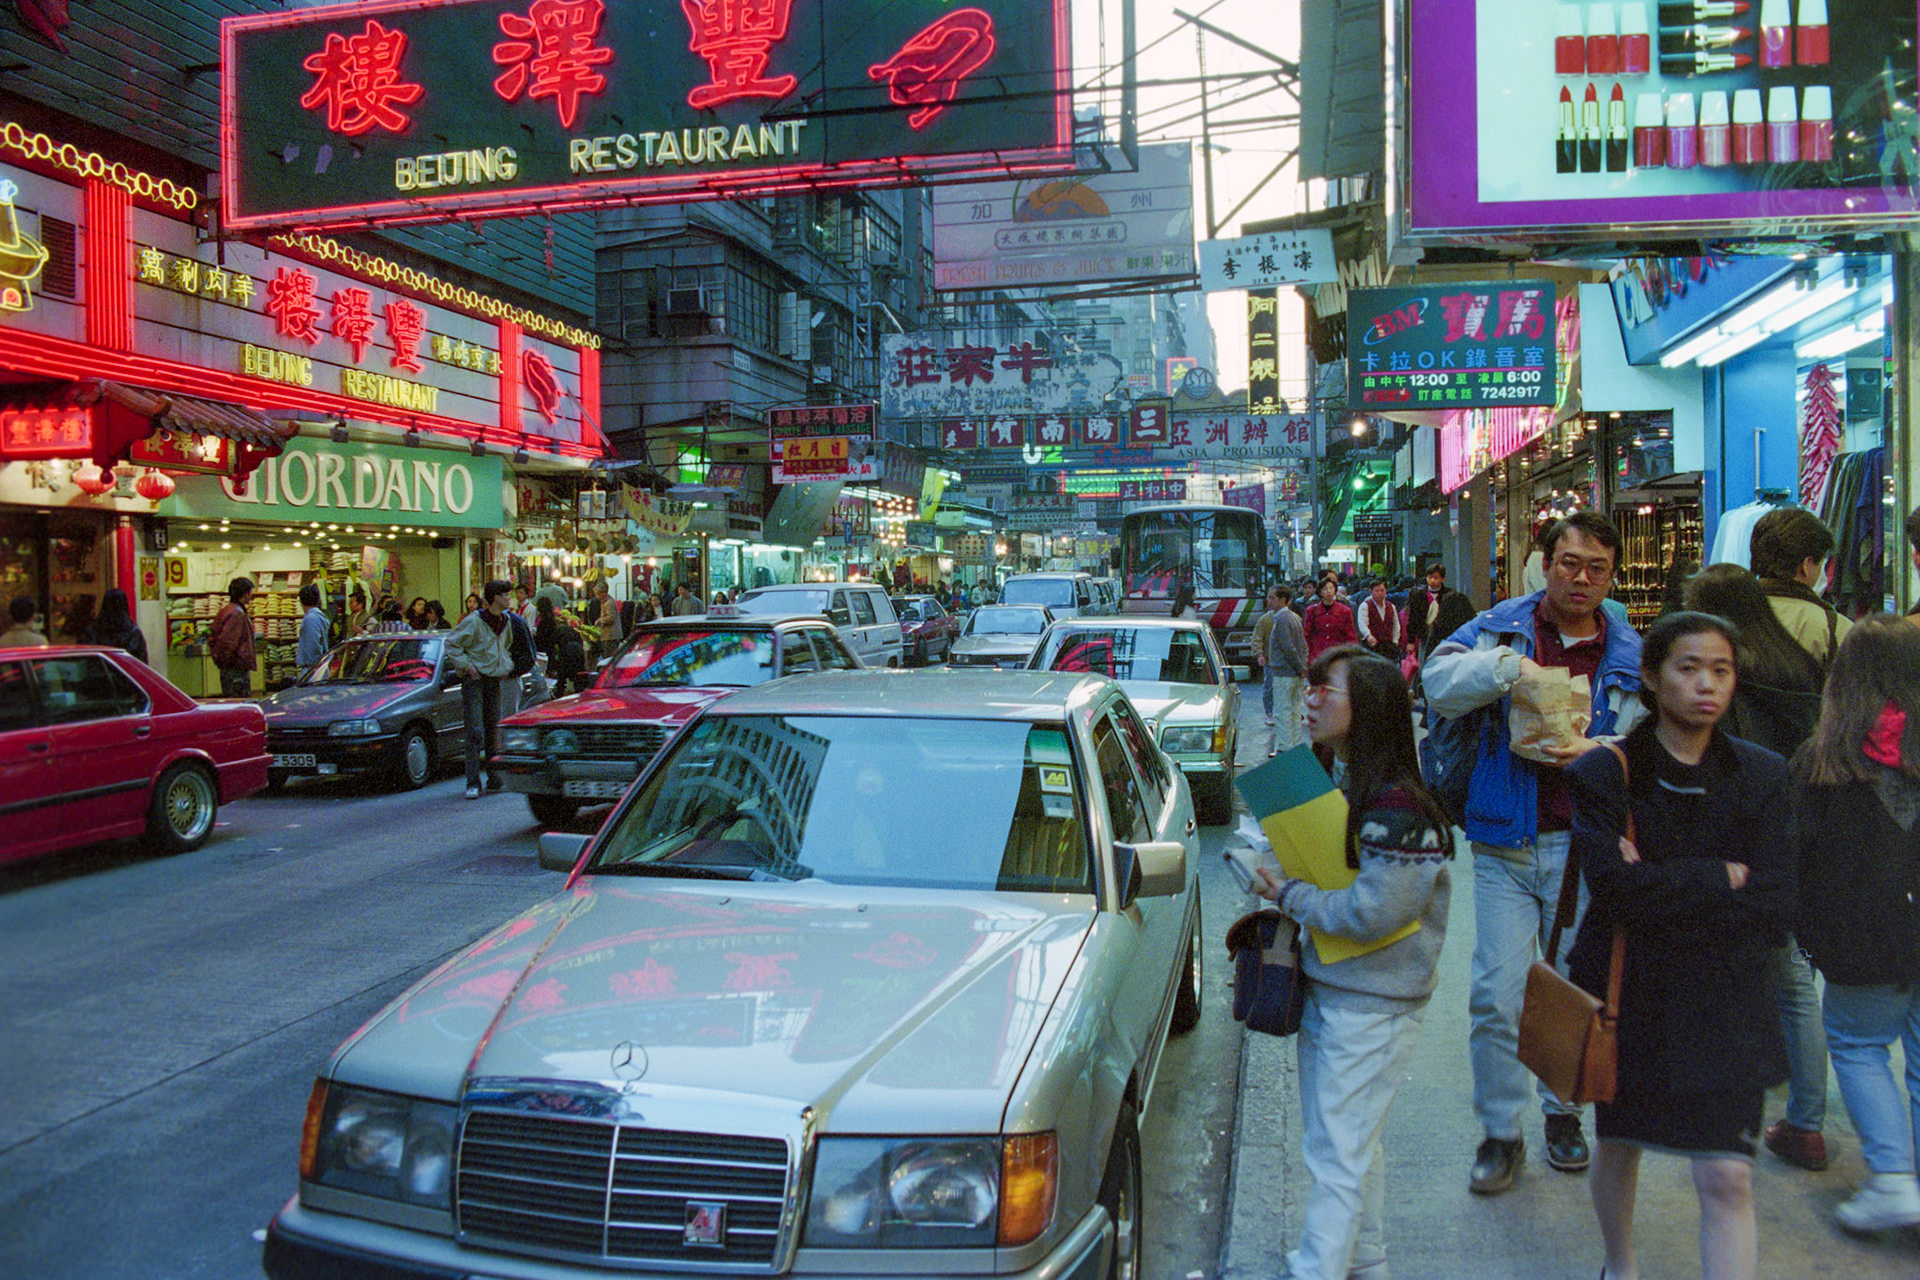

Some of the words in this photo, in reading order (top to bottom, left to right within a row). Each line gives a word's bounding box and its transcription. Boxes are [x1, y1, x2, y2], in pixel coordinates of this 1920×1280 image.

[395, 146, 518, 192] BEIJING
[569, 119, 808, 174] RESTAURANT
[1372, 302, 1425, 339] BM
[1440, 289, 1546, 344] 寶馬
[244, 342, 314, 387] BEIJING
[343, 368, 440, 414] RESTAURANT
[1409, 373, 1449, 387] 12:00
[1506, 370, 1541, 383] 6:00
[1480, 385, 1542, 400] 7242917
[1177, 447, 1208, 458] ASIA
[1223, 445, 1302, 457] PROVISIONS
[281, 755, 315, 767] 5309
